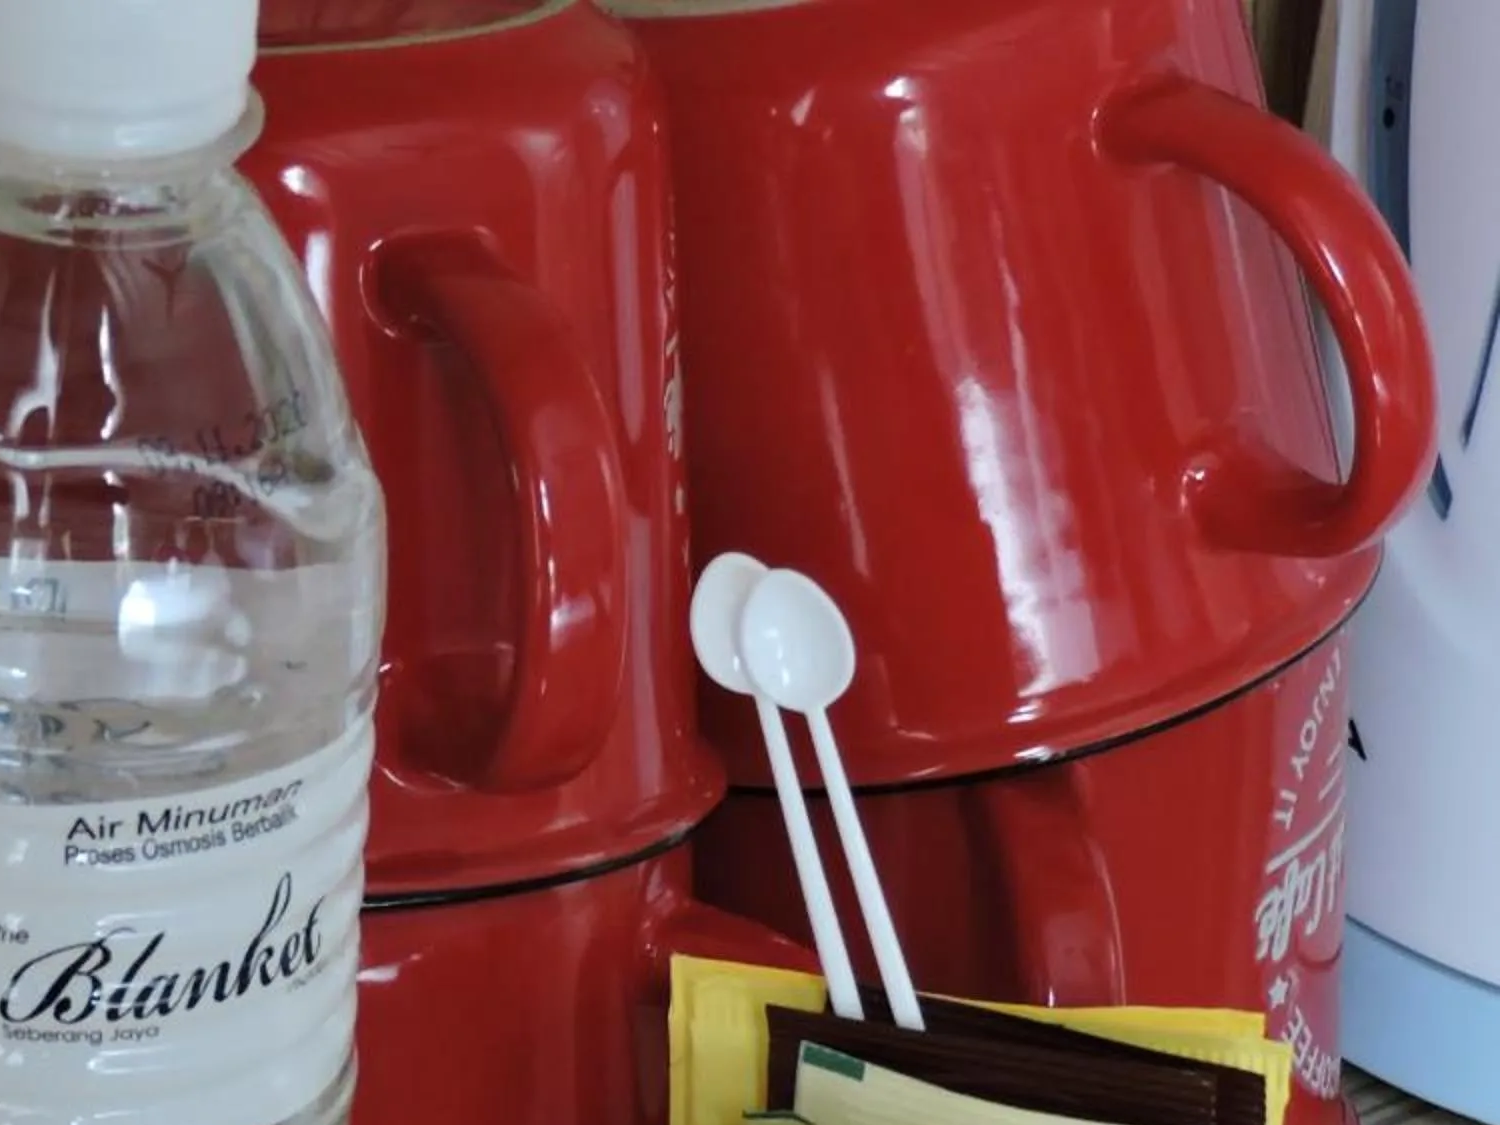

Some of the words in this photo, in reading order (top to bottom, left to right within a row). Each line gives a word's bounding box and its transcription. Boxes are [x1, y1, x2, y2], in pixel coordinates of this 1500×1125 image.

[66, 812, 124, 841] Air
[136, 778, 304, 836] Minuman
[1272, 789, 1298, 832] IT
[141, 825, 227, 861] Osmosis
[0, 871, 326, 1026] Blanket
[109, 1024, 162, 1043] Jaya
